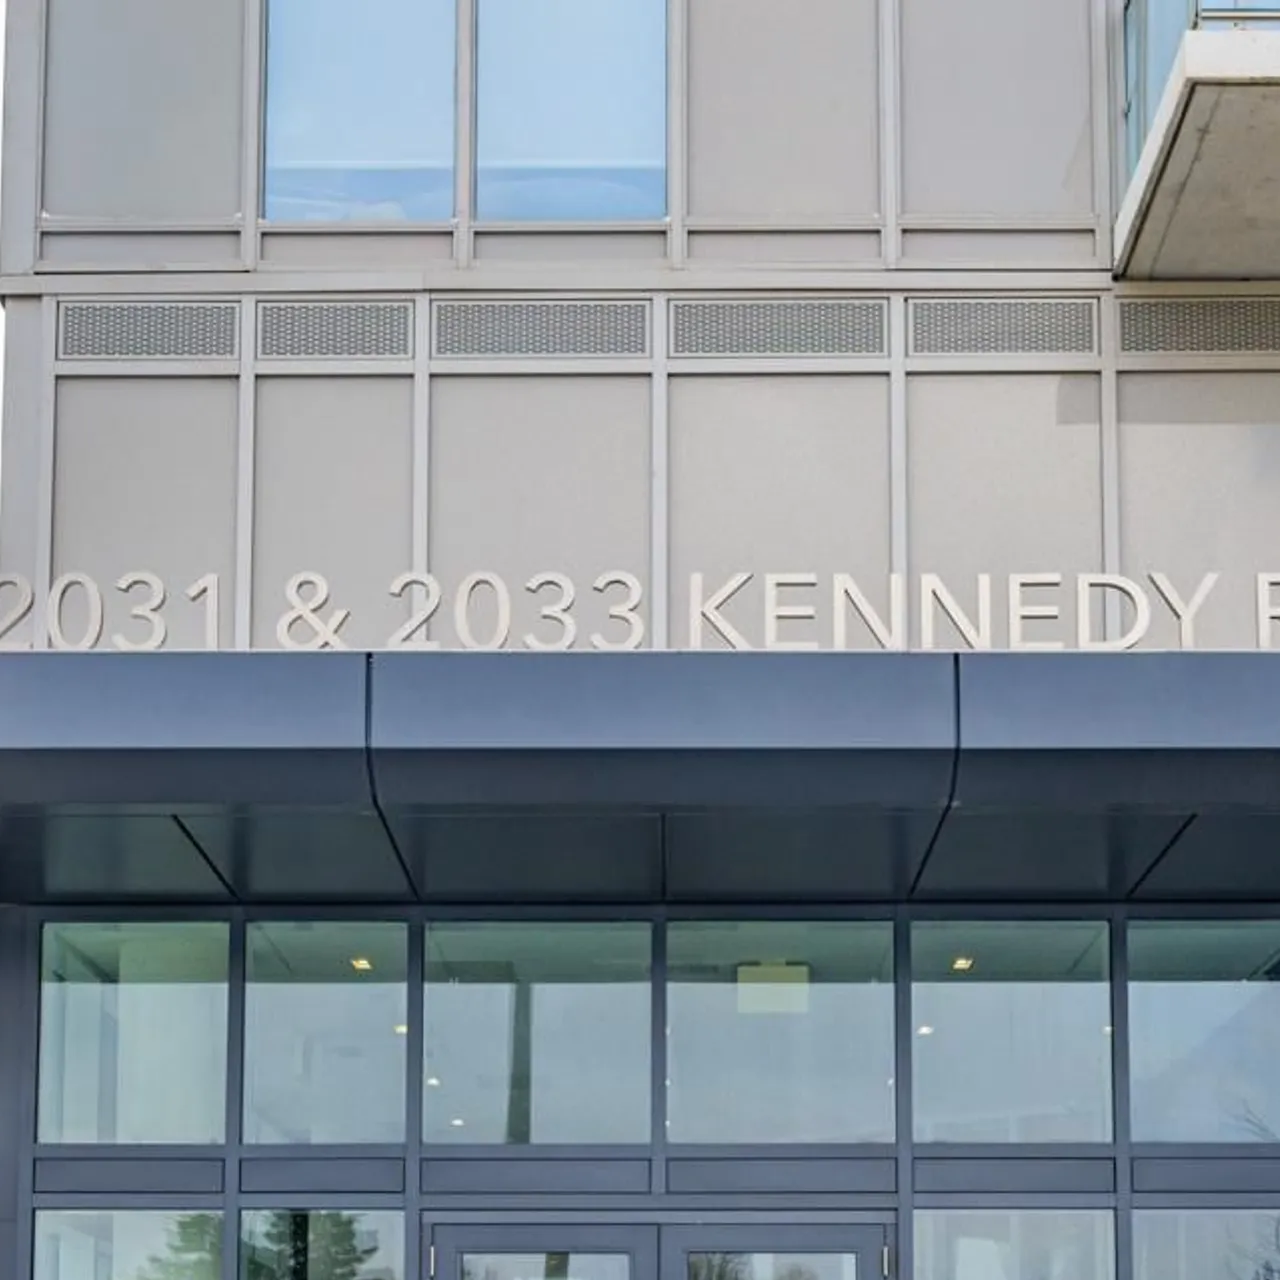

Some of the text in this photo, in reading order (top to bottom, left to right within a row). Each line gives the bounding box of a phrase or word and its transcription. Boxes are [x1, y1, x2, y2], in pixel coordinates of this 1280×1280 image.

[276, 571, 350, 649] &
[387, 571, 646, 649] 2033
[689, 572, 1219, 649] KENNEDY
